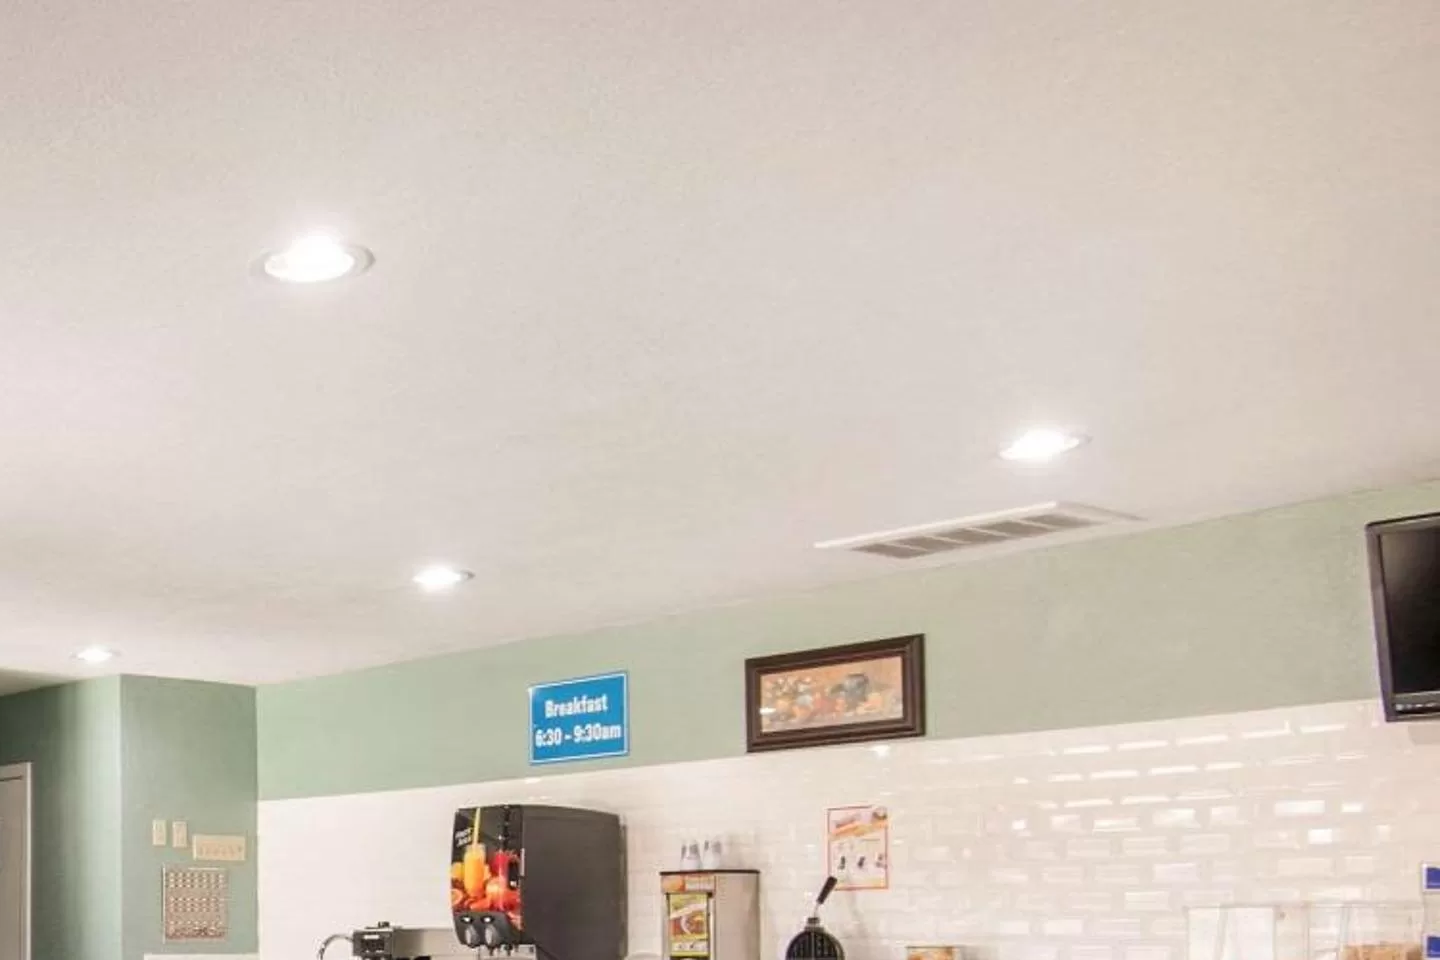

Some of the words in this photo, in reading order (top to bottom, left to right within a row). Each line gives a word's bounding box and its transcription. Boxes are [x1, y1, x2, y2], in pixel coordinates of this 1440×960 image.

[544, 694, 608, 718] Breakfast
[535, 728, 561, 747] 6:30
[573, 723, 621, 743] 9:30am
